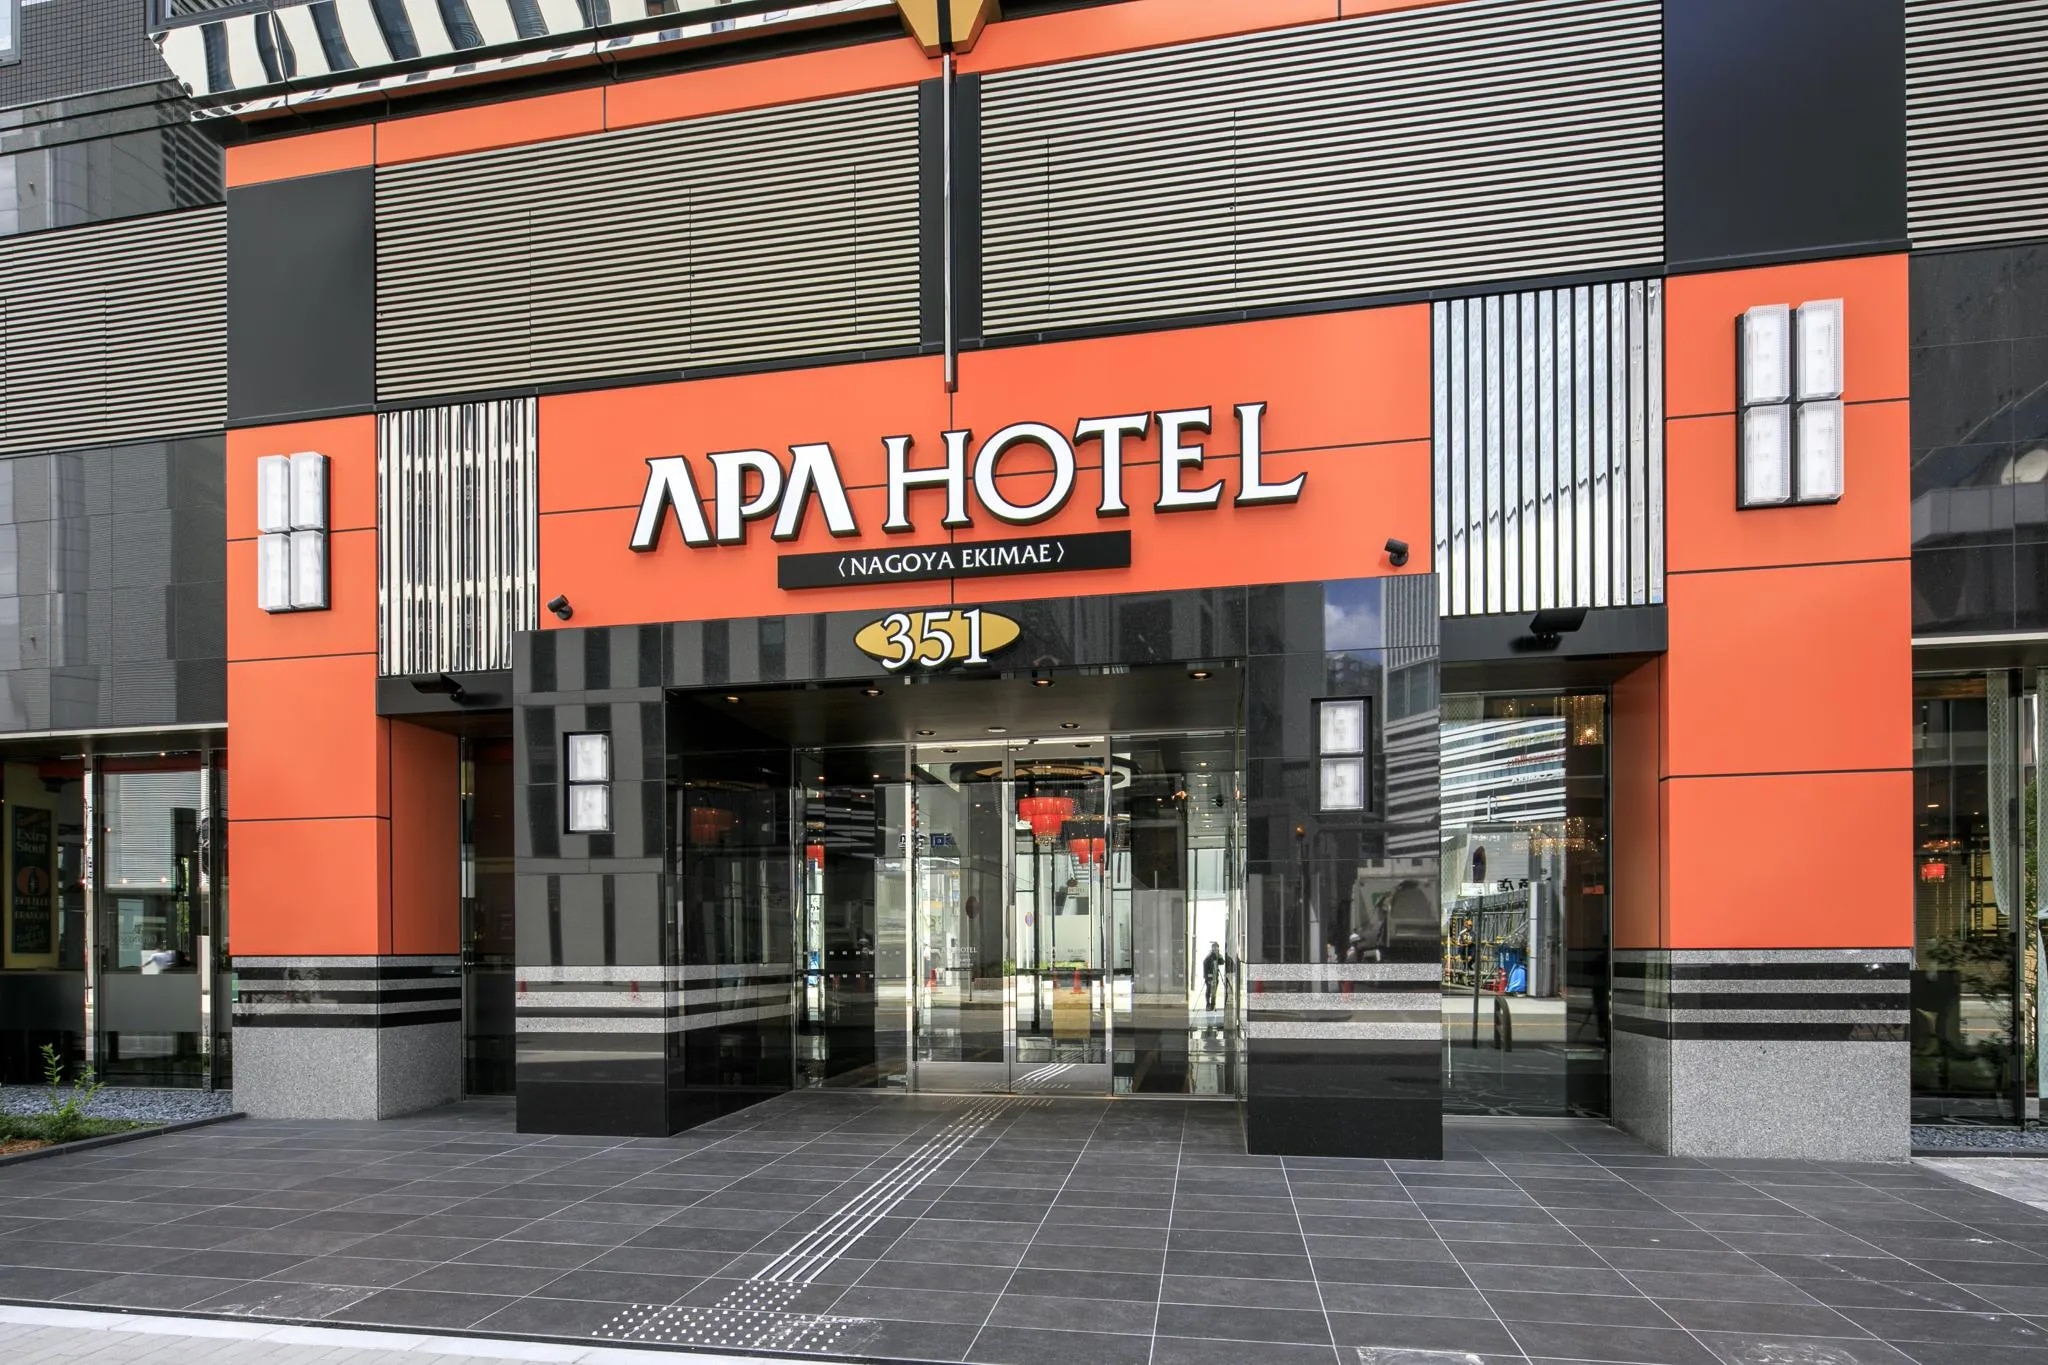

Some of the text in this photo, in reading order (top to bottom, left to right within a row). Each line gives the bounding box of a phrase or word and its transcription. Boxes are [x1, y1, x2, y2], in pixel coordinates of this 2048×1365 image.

[629, 401, 1308, 553] APA HOTEL
[880, 608, 989, 670] 351
